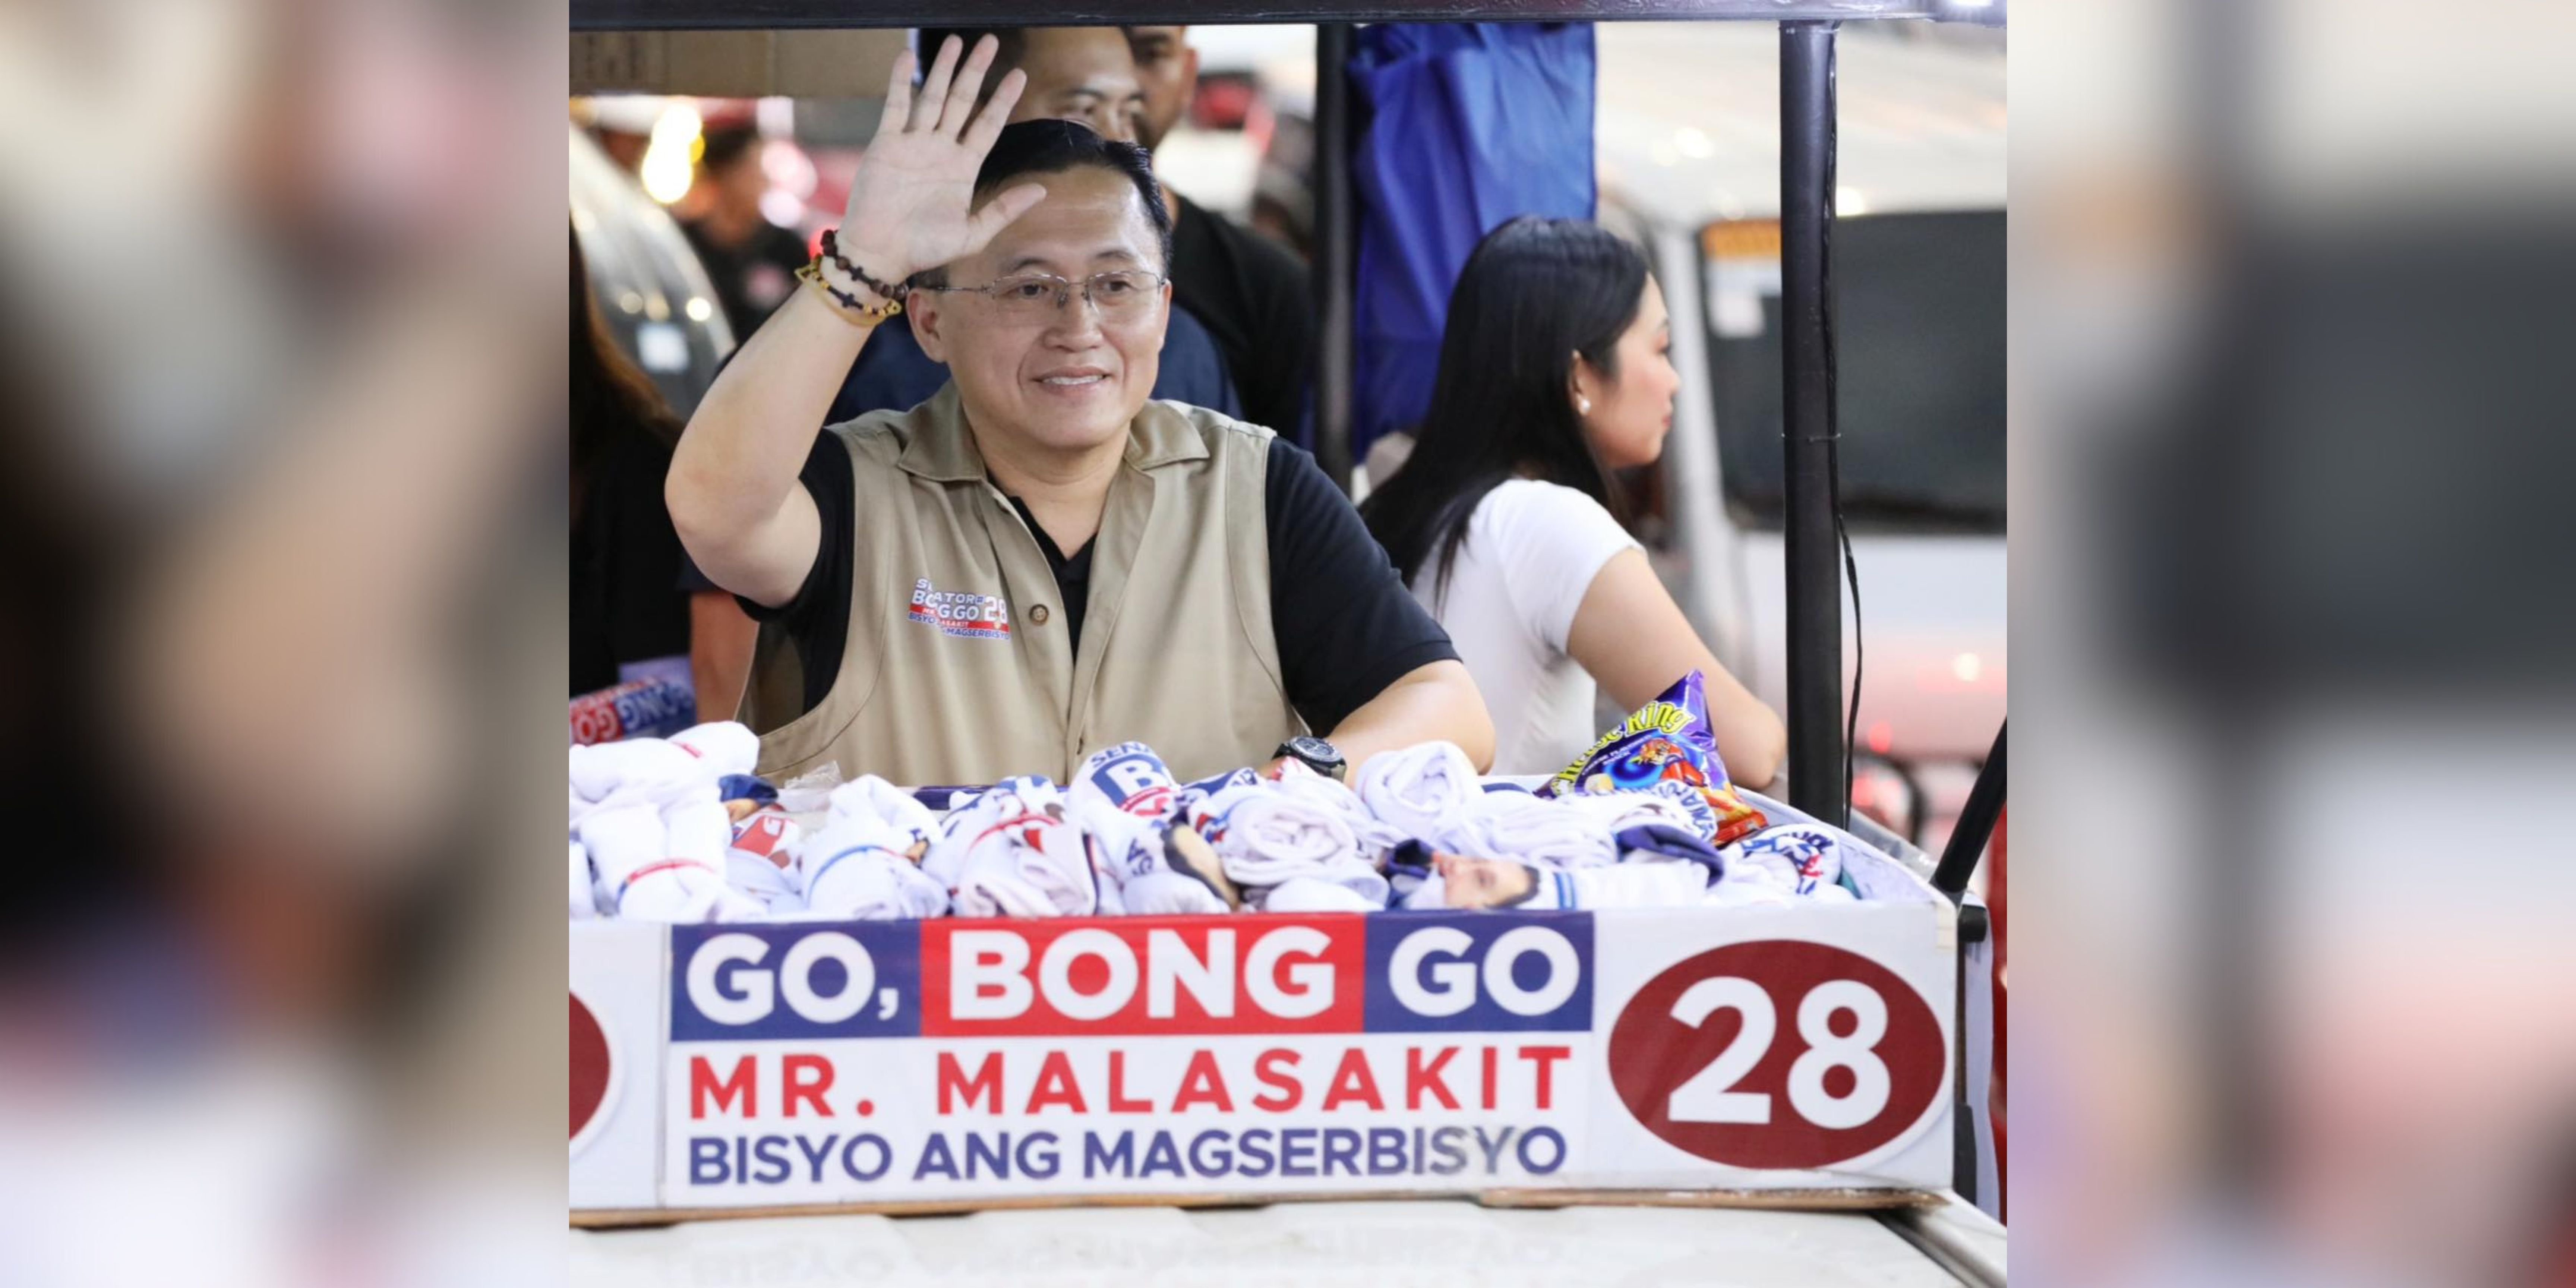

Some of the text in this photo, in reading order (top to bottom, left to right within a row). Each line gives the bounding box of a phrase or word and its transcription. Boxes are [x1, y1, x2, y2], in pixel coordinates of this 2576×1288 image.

[953, 604, 979, 621] GO
[984, 596, 1008, 624] 28
[686, 926, 1580, 1025] GO, BONG GO
[690, 1046, 1571, 1119] MR. MALASAKIT
[1668, 976, 1891, 1130] 28
[689, 1126, 1566, 1186] BISYO ANG MAGSERBISYO
